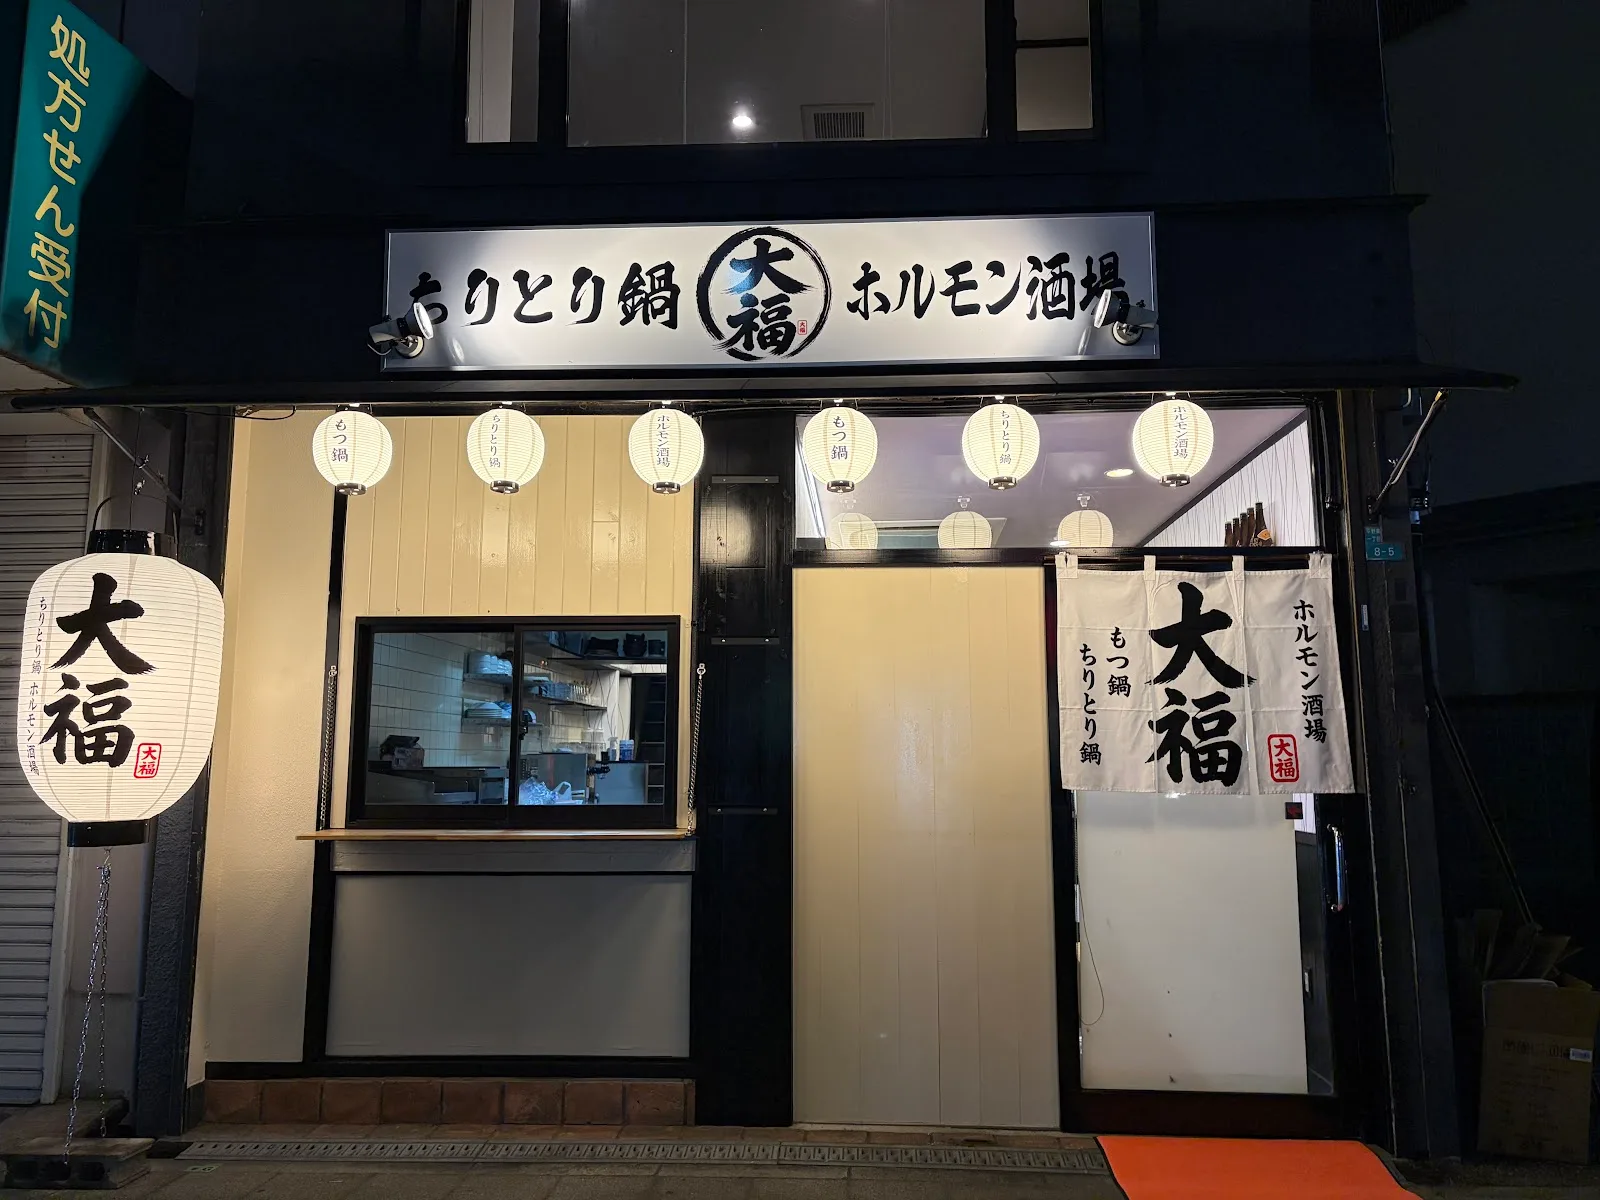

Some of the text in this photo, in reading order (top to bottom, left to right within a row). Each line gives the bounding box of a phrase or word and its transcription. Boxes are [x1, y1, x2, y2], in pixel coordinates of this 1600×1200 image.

[24, 15, 90, 348] 処方せん受付
[408, 262, 681, 330] ちりとり鍋
[712, 238, 818, 356] 大福
[846, 251, 1130, 321] ホルモン酒場
[331, 418, 349, 463] もつ鍋
[489, 414, 501, 468] ちりとり鍋
[656, 414, 671, 468] ホルモン酒場
[831, 415, 848, 460] もつ鍋
[999, 409, 1012, 465] ちりとり鍋
[1172, 405, 1189, 459] ホルモン酒場
[1374, 547, 1395, 556] 8-5
[26, 596, 48, 776] ちりとり鍋 ホルモン酒場
[39, 572, 159, 768] 大福
[1106, 626, 1131, 698] もつ鍋
[1144, 581, 1257, 787] 大福
[1293, 599, 1328, 743] ホルモン酒場
[1079, 643, 1101, 766] ちりとり鍋
[139, 747, 156, 774] 大福
[1273, 738, 1295, 778] 大福
